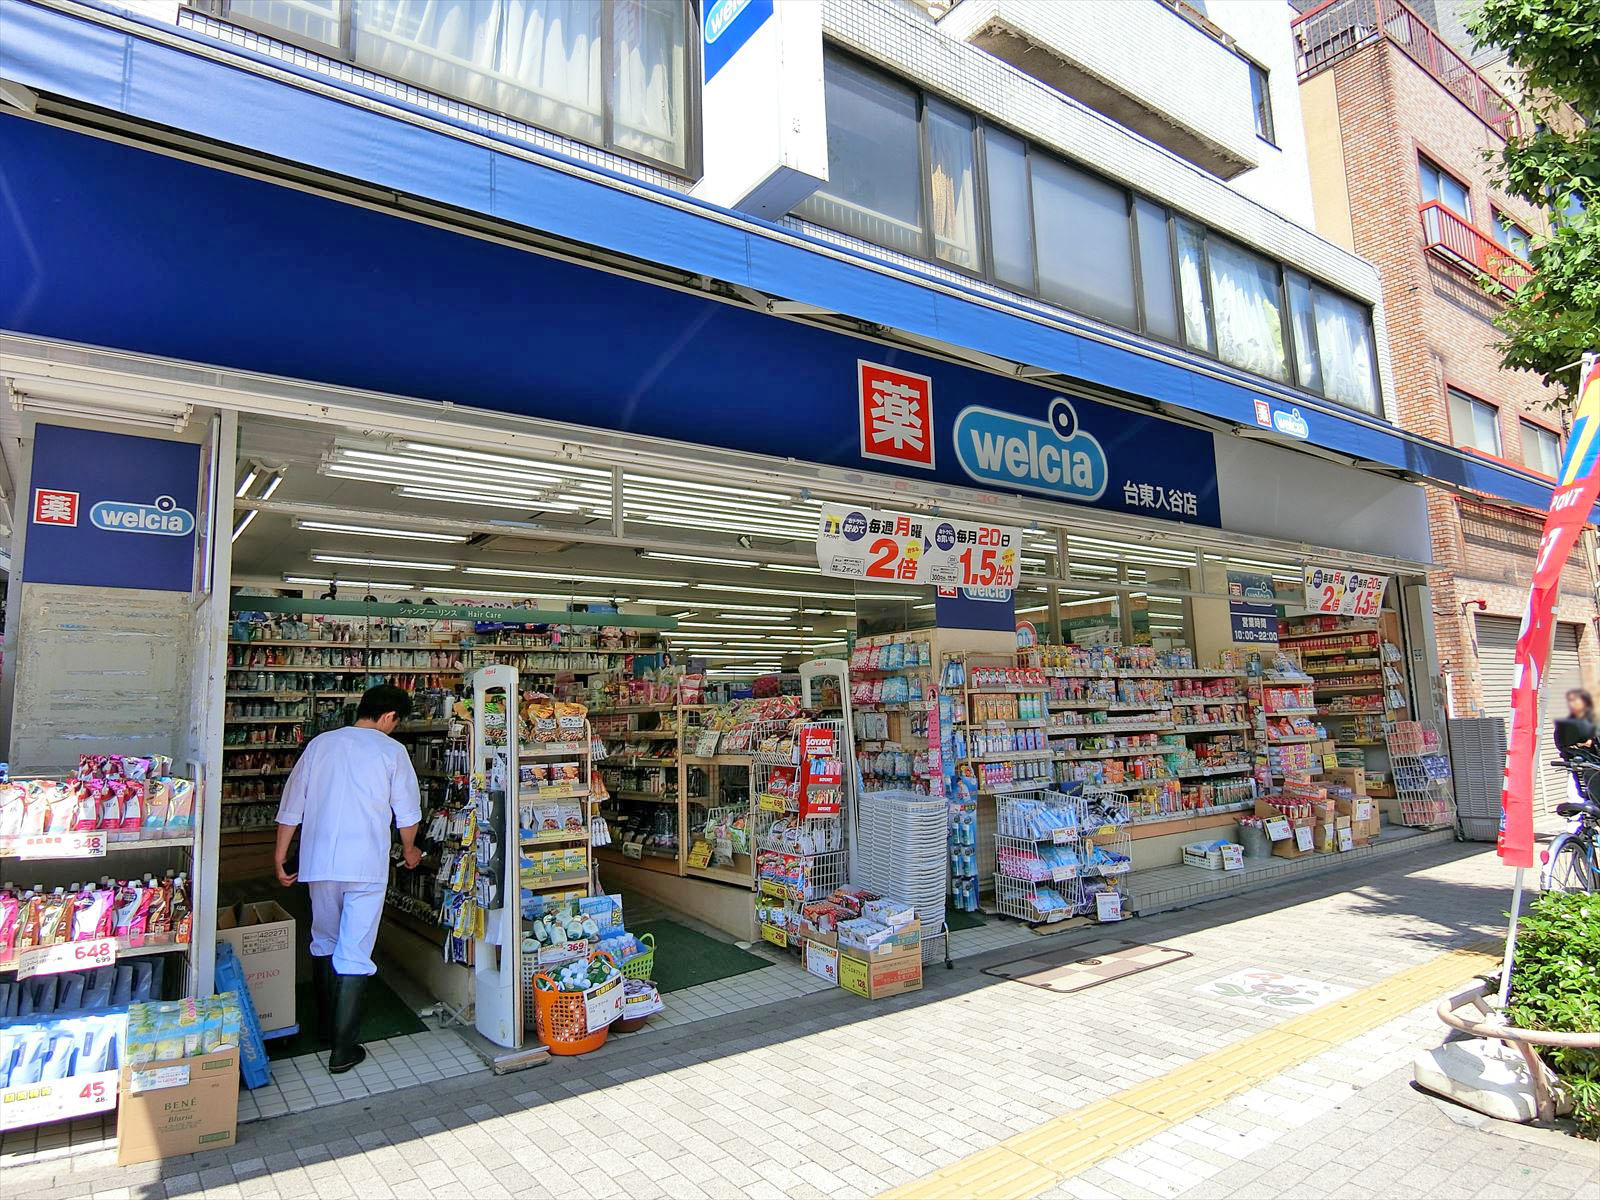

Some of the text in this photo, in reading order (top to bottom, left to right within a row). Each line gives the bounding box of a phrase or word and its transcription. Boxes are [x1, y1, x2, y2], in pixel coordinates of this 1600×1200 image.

[711, 0, 746, 35] wel
[871, 379, 924, 451] 薬
[1277, 415, 1306, 436] welcia
[970, 428, 1094, 489] welcia
[40, 494, 72, 521] 薬
[1123, 480, 1198, 517] 台東入谷店
[101, 508, 184, 532] welcia
[843, 523, 867, 535] 貯めて
[868, 516, 923, 539] 毎週月曜
[956, 527, 1011, 547] 毎月20日
[865, 538, 918, 580] 2倍
[959, 547, 1014, 587] 1.5倍分
[399, 607, 458, 617] シャンプー・リンス
[467, 610, 502, 619] Hair Care
[805, 738, 832, 746] SOYJOY
[73, 837, 101, 849] 348
[75, 942, 110, 960] 648
[567, 942, 584, 952] 369
[95, 956, 111, 964] 699
[79, 1081, 105, 1099] 45
[164, 1096, 198, 1111] BENÉ
